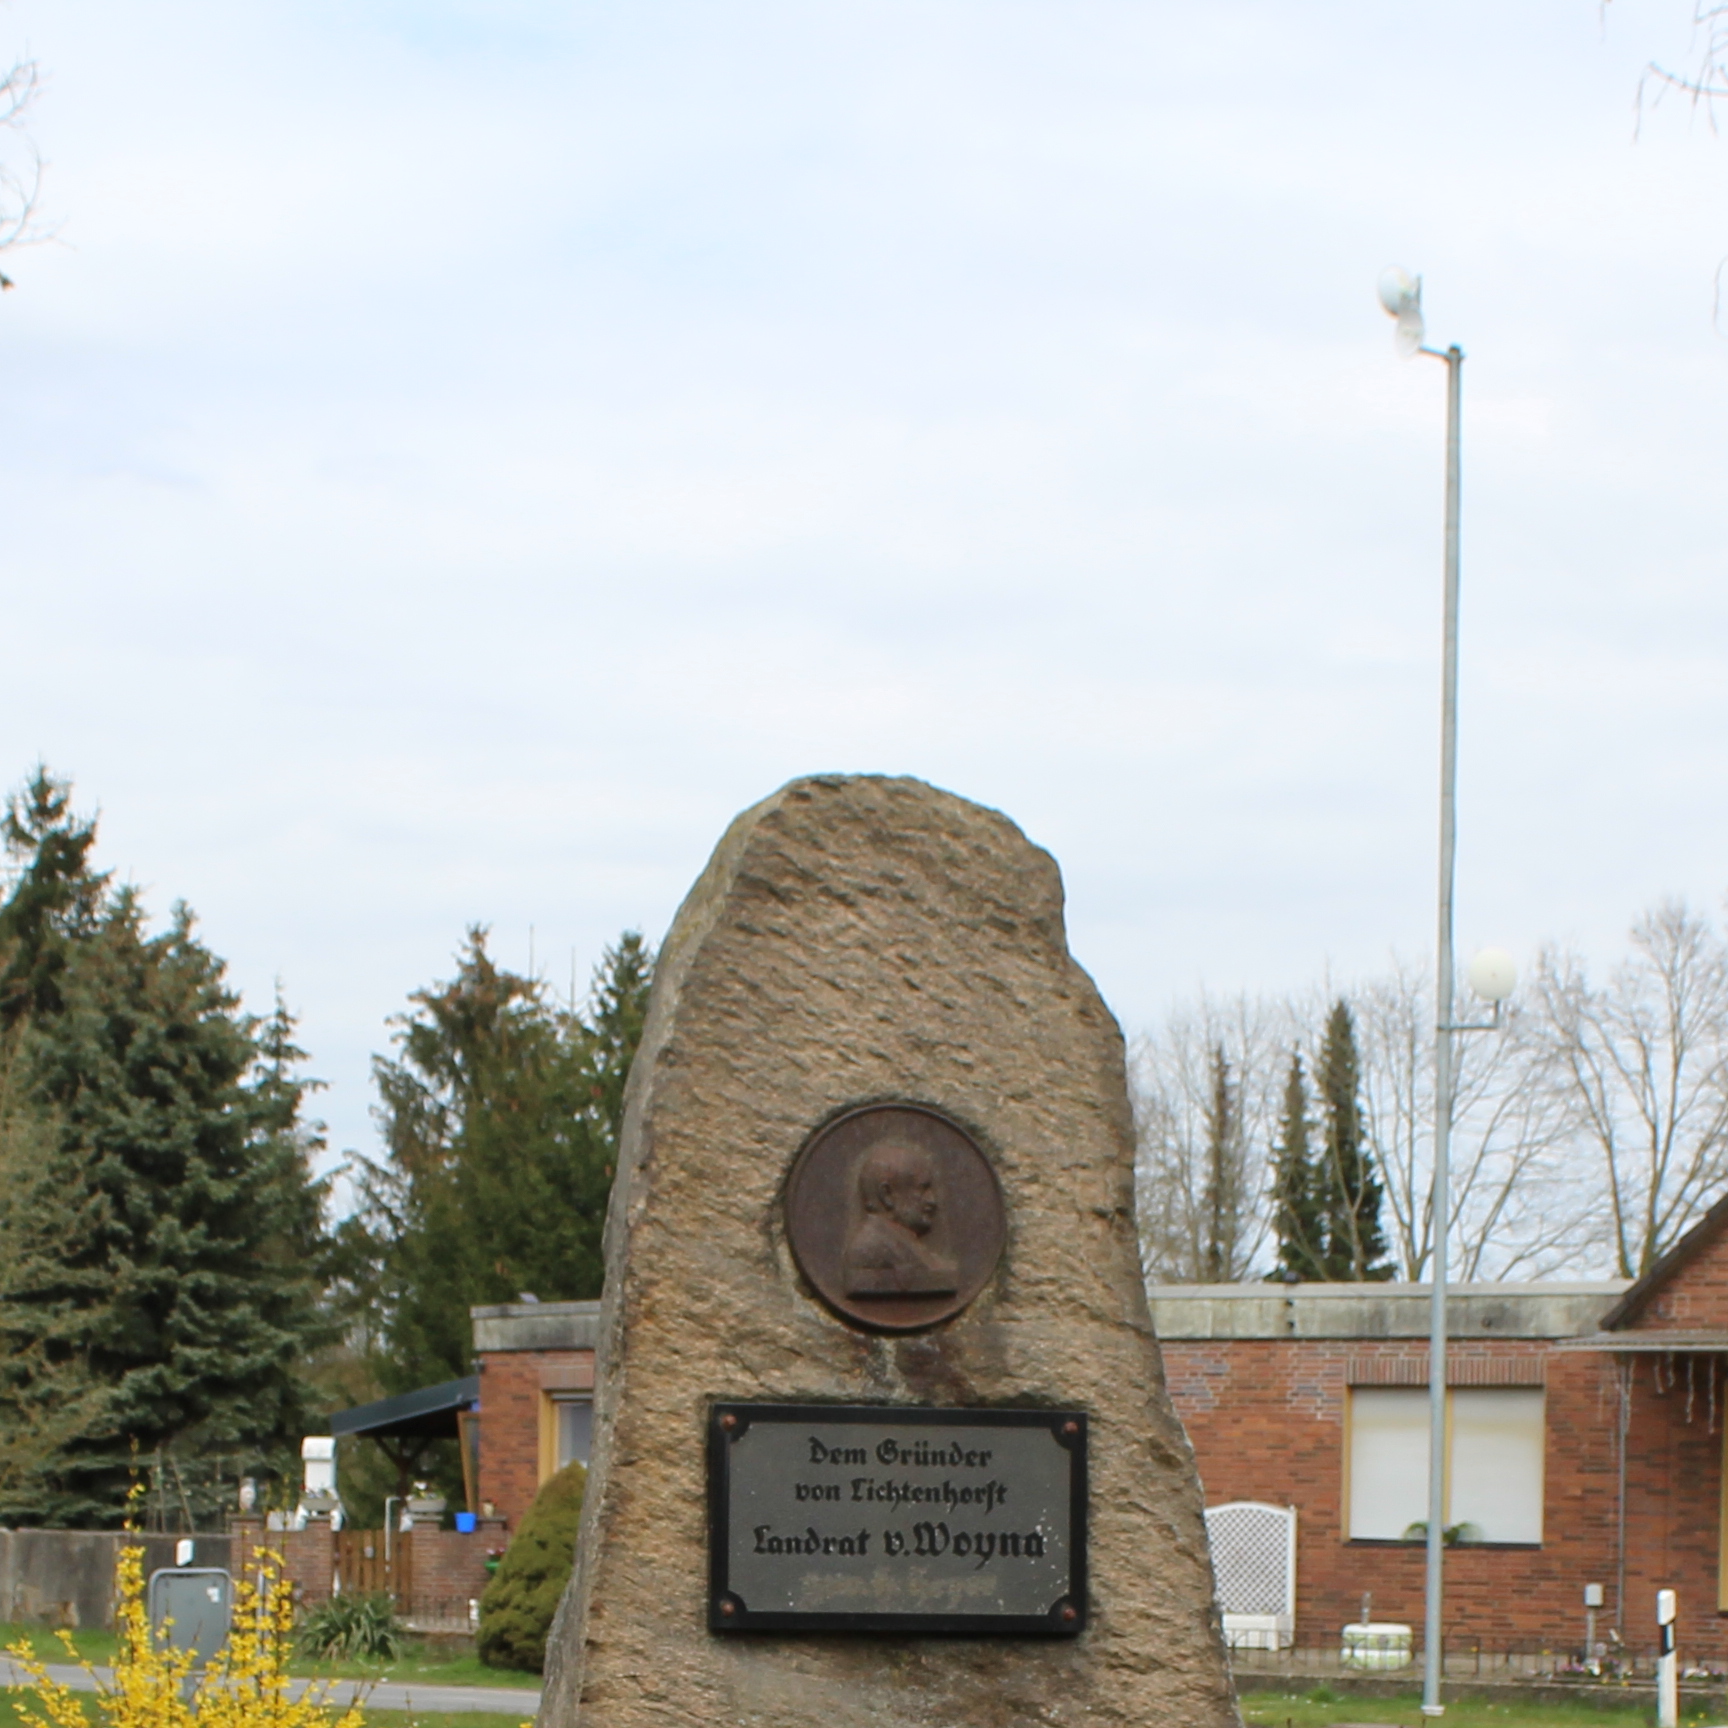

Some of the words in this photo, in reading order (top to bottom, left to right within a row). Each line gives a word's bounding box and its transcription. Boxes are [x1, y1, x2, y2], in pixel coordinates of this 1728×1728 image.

[808, 1436, 867, 1466] Dem
[876, 1438, 993, 1468] Gründer
[795, 1481, 841, 1503] von
[753, 1524, 871, 1557] Landrat
